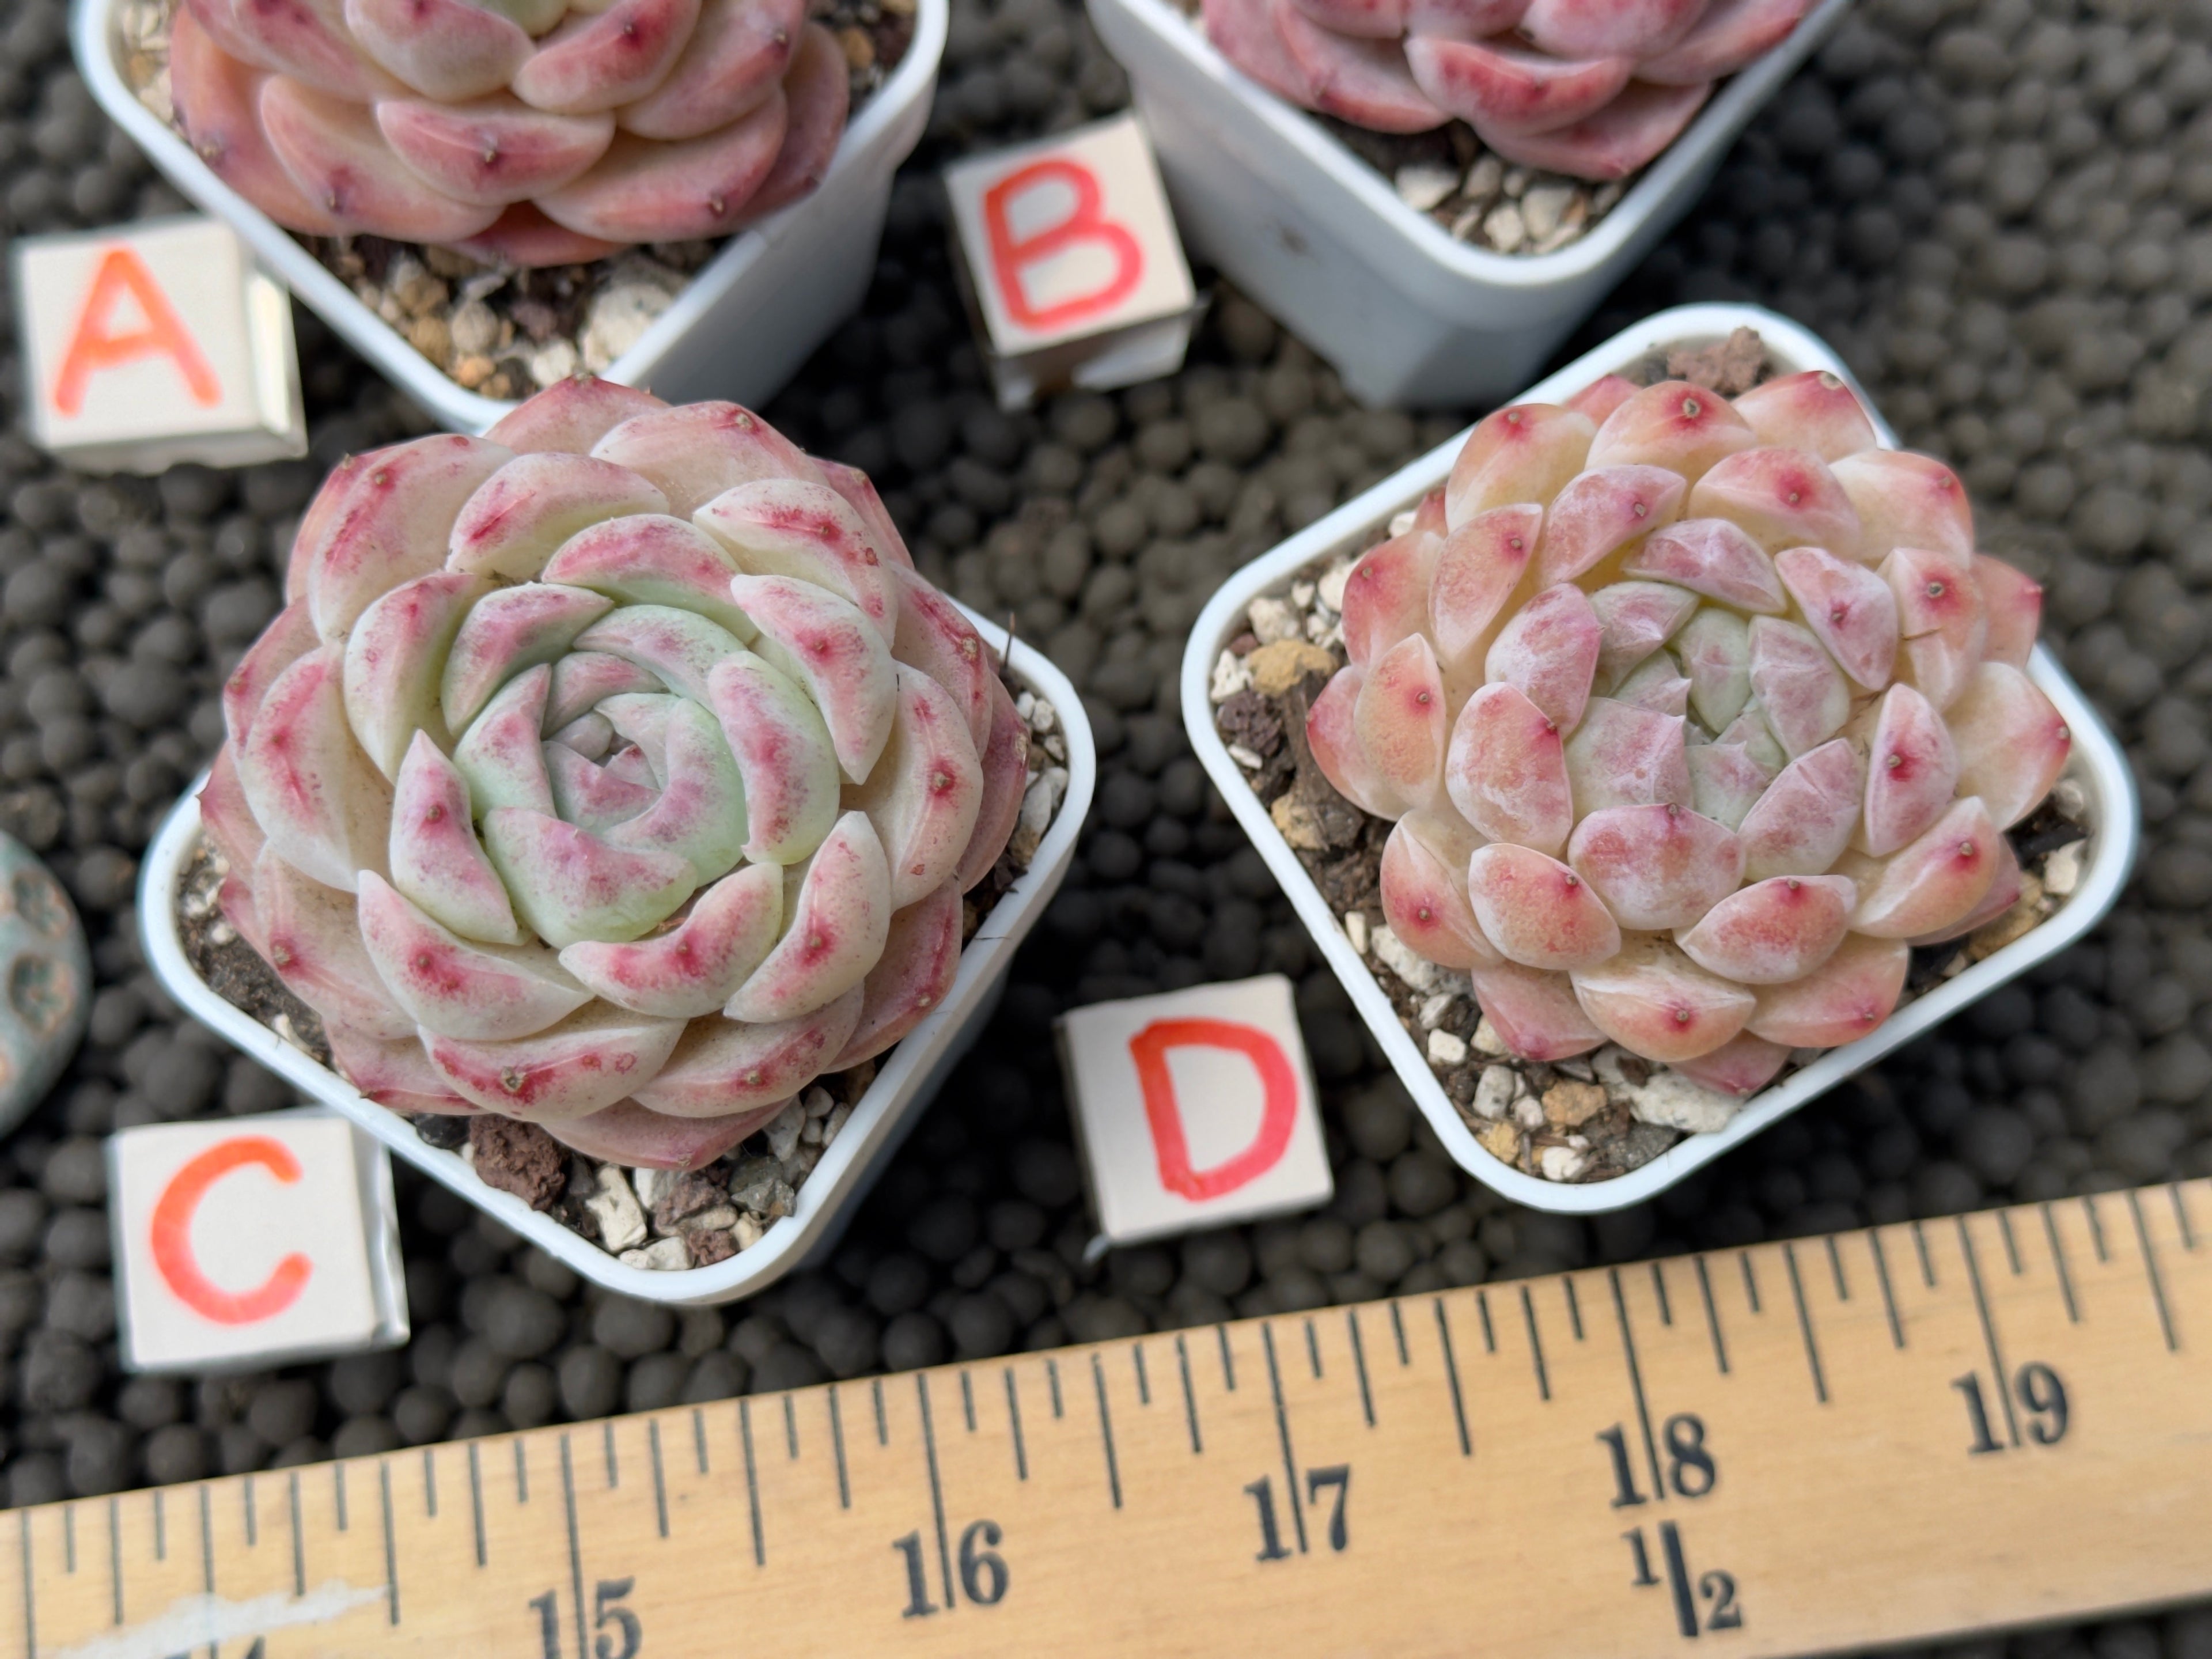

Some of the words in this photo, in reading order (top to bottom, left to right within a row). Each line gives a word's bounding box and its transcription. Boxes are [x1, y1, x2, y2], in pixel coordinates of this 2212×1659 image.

[53, 242, 224, 419] A
[983, 156, 1144, 334] B
[1127, 1016, 1298, 1204] D
[148, 1134, 313, 1327] C
[528, 1575, 643, 1659] 15
[890, 1517, 1012, 1620] 16
[1243, 1461, 1351, 1563] 17
[1595, 1411, 1717, 1508] 18
[1948, 1359, 2069, 1454] 19
